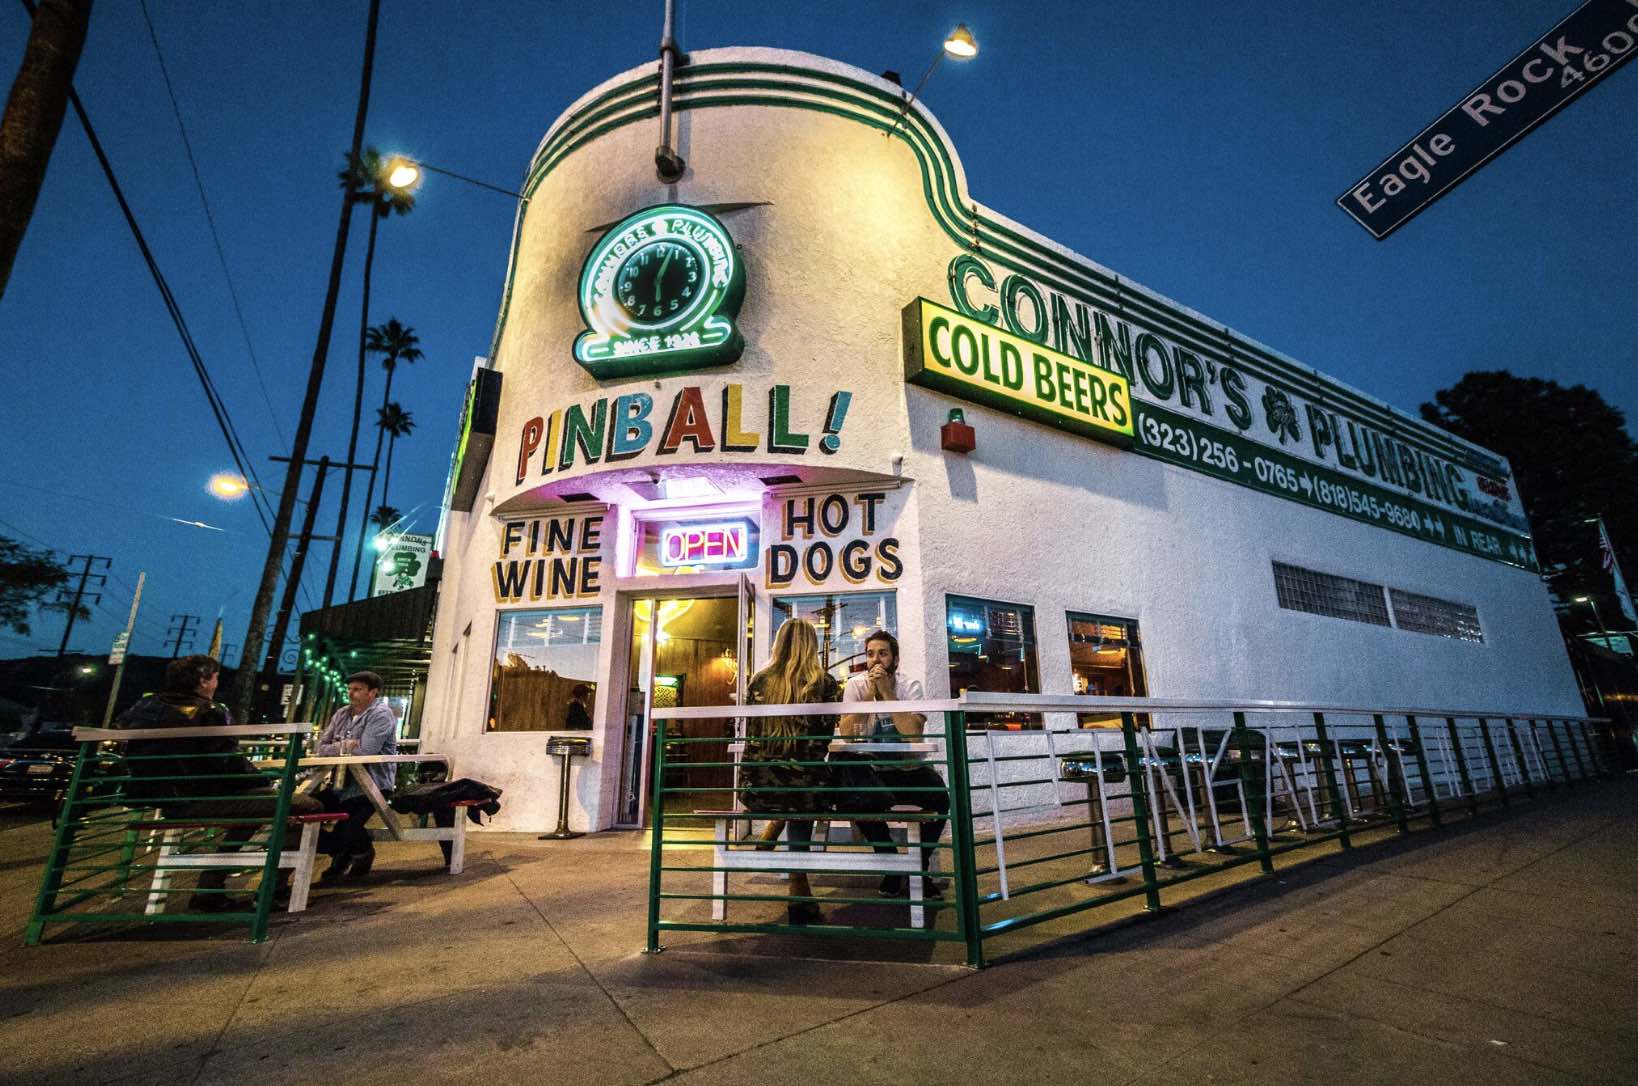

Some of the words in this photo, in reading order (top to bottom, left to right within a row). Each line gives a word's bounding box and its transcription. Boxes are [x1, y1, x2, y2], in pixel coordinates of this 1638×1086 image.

[1353, 133, 1456, 214] Eagle
[1461, 36, 1585, 127] Rock
[656, 245, 666, 257] 12
[674, 250, 680, 260] 1
[640, 253, 649, 265] 11
[685, 257, 695, 267] 2
[629, 266, 639, 278] 10
[688, 272, 697, 283] 3
[624, 281, 632, 292] 9
[681, 286, 692, 298] 4
[627, 295, 636, 307] 8
[670, 300, 679, 311] 5
[637, 305, 647, 316] 7
[653, 305, 662, 316] 6
[947, 254, 1253, 430] CONNOR'S
[928, 316, 1023, 391] COLD
[1033, 352, 1129, 427] BEERS
[516, 384, 852, 487] PINBALL!
[781, 492, 887, 538] HOT
[500, 516, 605, 558] FINE
[666, 527, 745, 561] OPEN
[765, 537, 904, 590] DOGS
[492, 556, 603, 599] WINE
